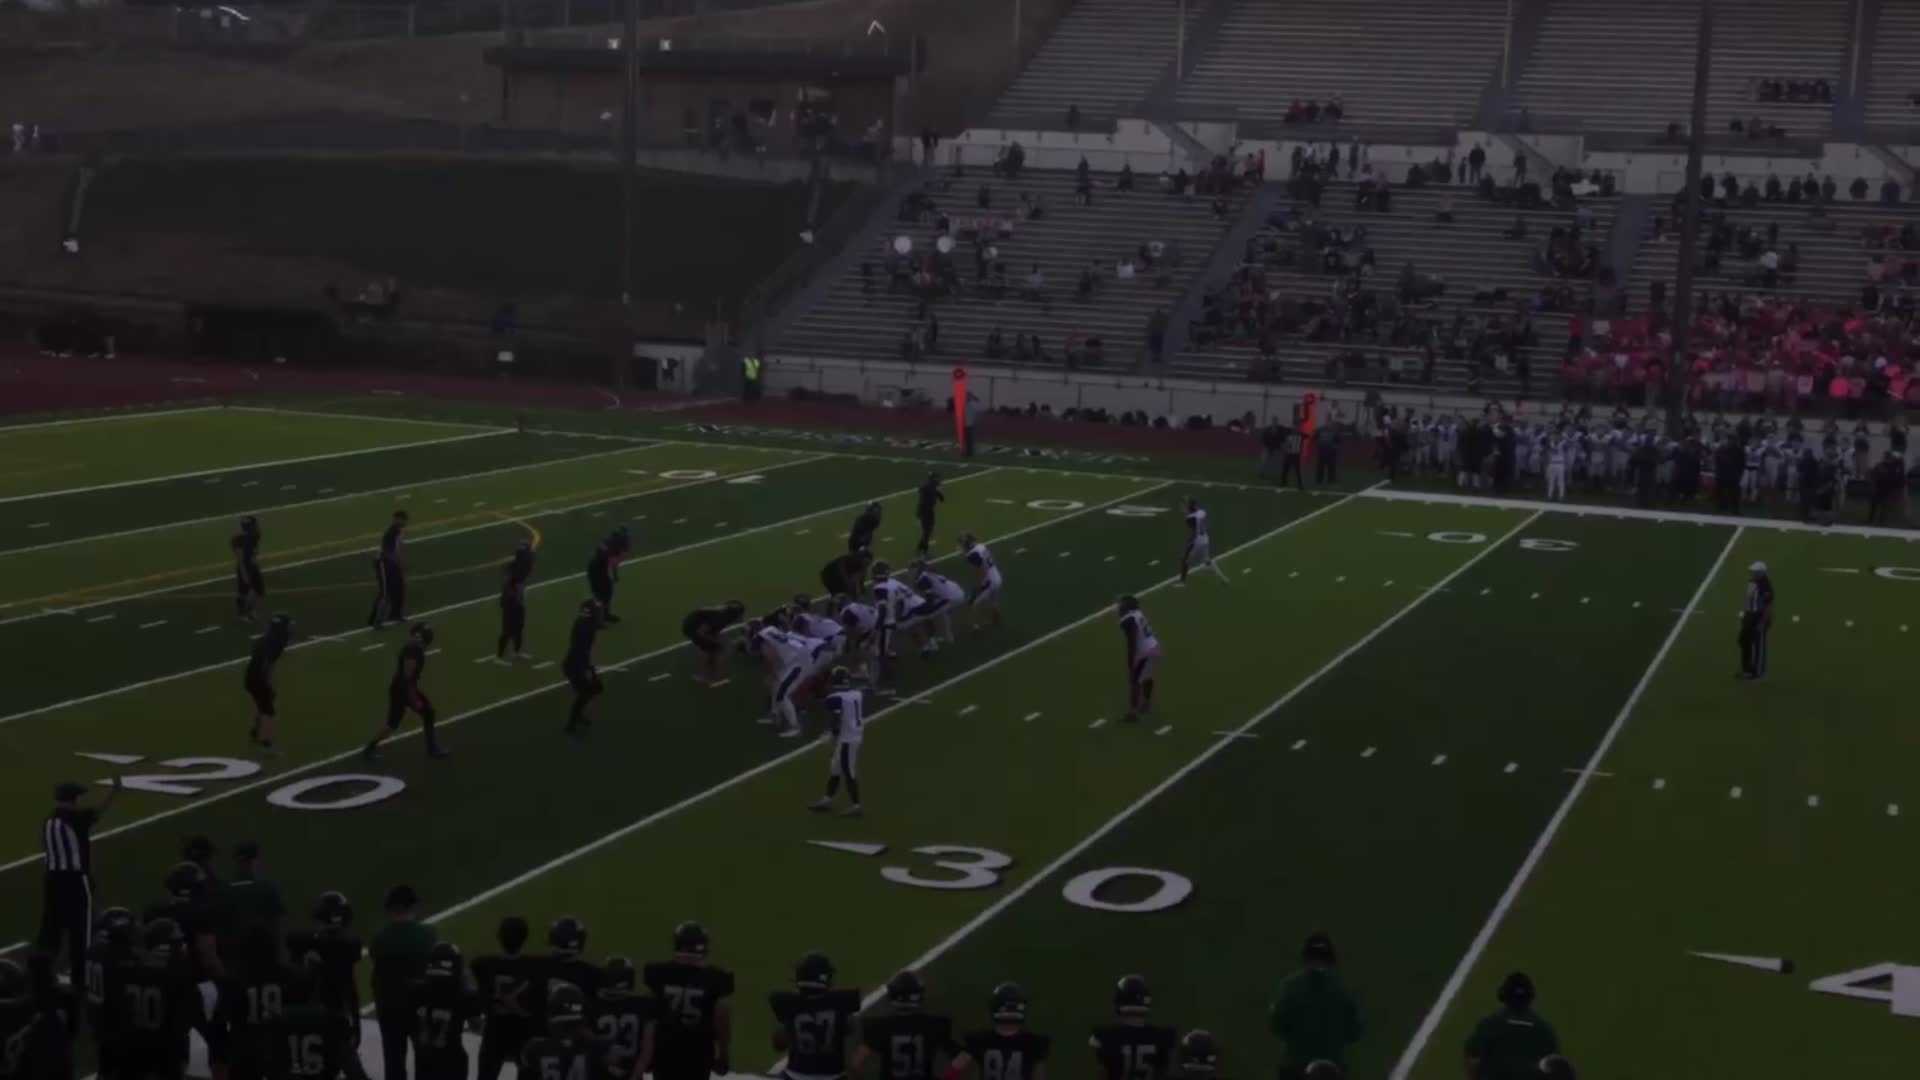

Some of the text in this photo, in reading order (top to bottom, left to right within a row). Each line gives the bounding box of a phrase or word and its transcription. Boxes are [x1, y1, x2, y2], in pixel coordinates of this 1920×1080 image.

[95, 756, 405, 810] 20
[881, 845, 1194, 912] 30
[663, 985, 704, 1025] 75
[415, 1007, 452, 1048] 17
[596, 1013, 638, 1057] 23
[793, 1010, 835, 1055] 67
[286, 1033, 323, 1076] 16
[890, 1034, 924, 1078] 51
[1119, 1044, 1157, 1080] 15
